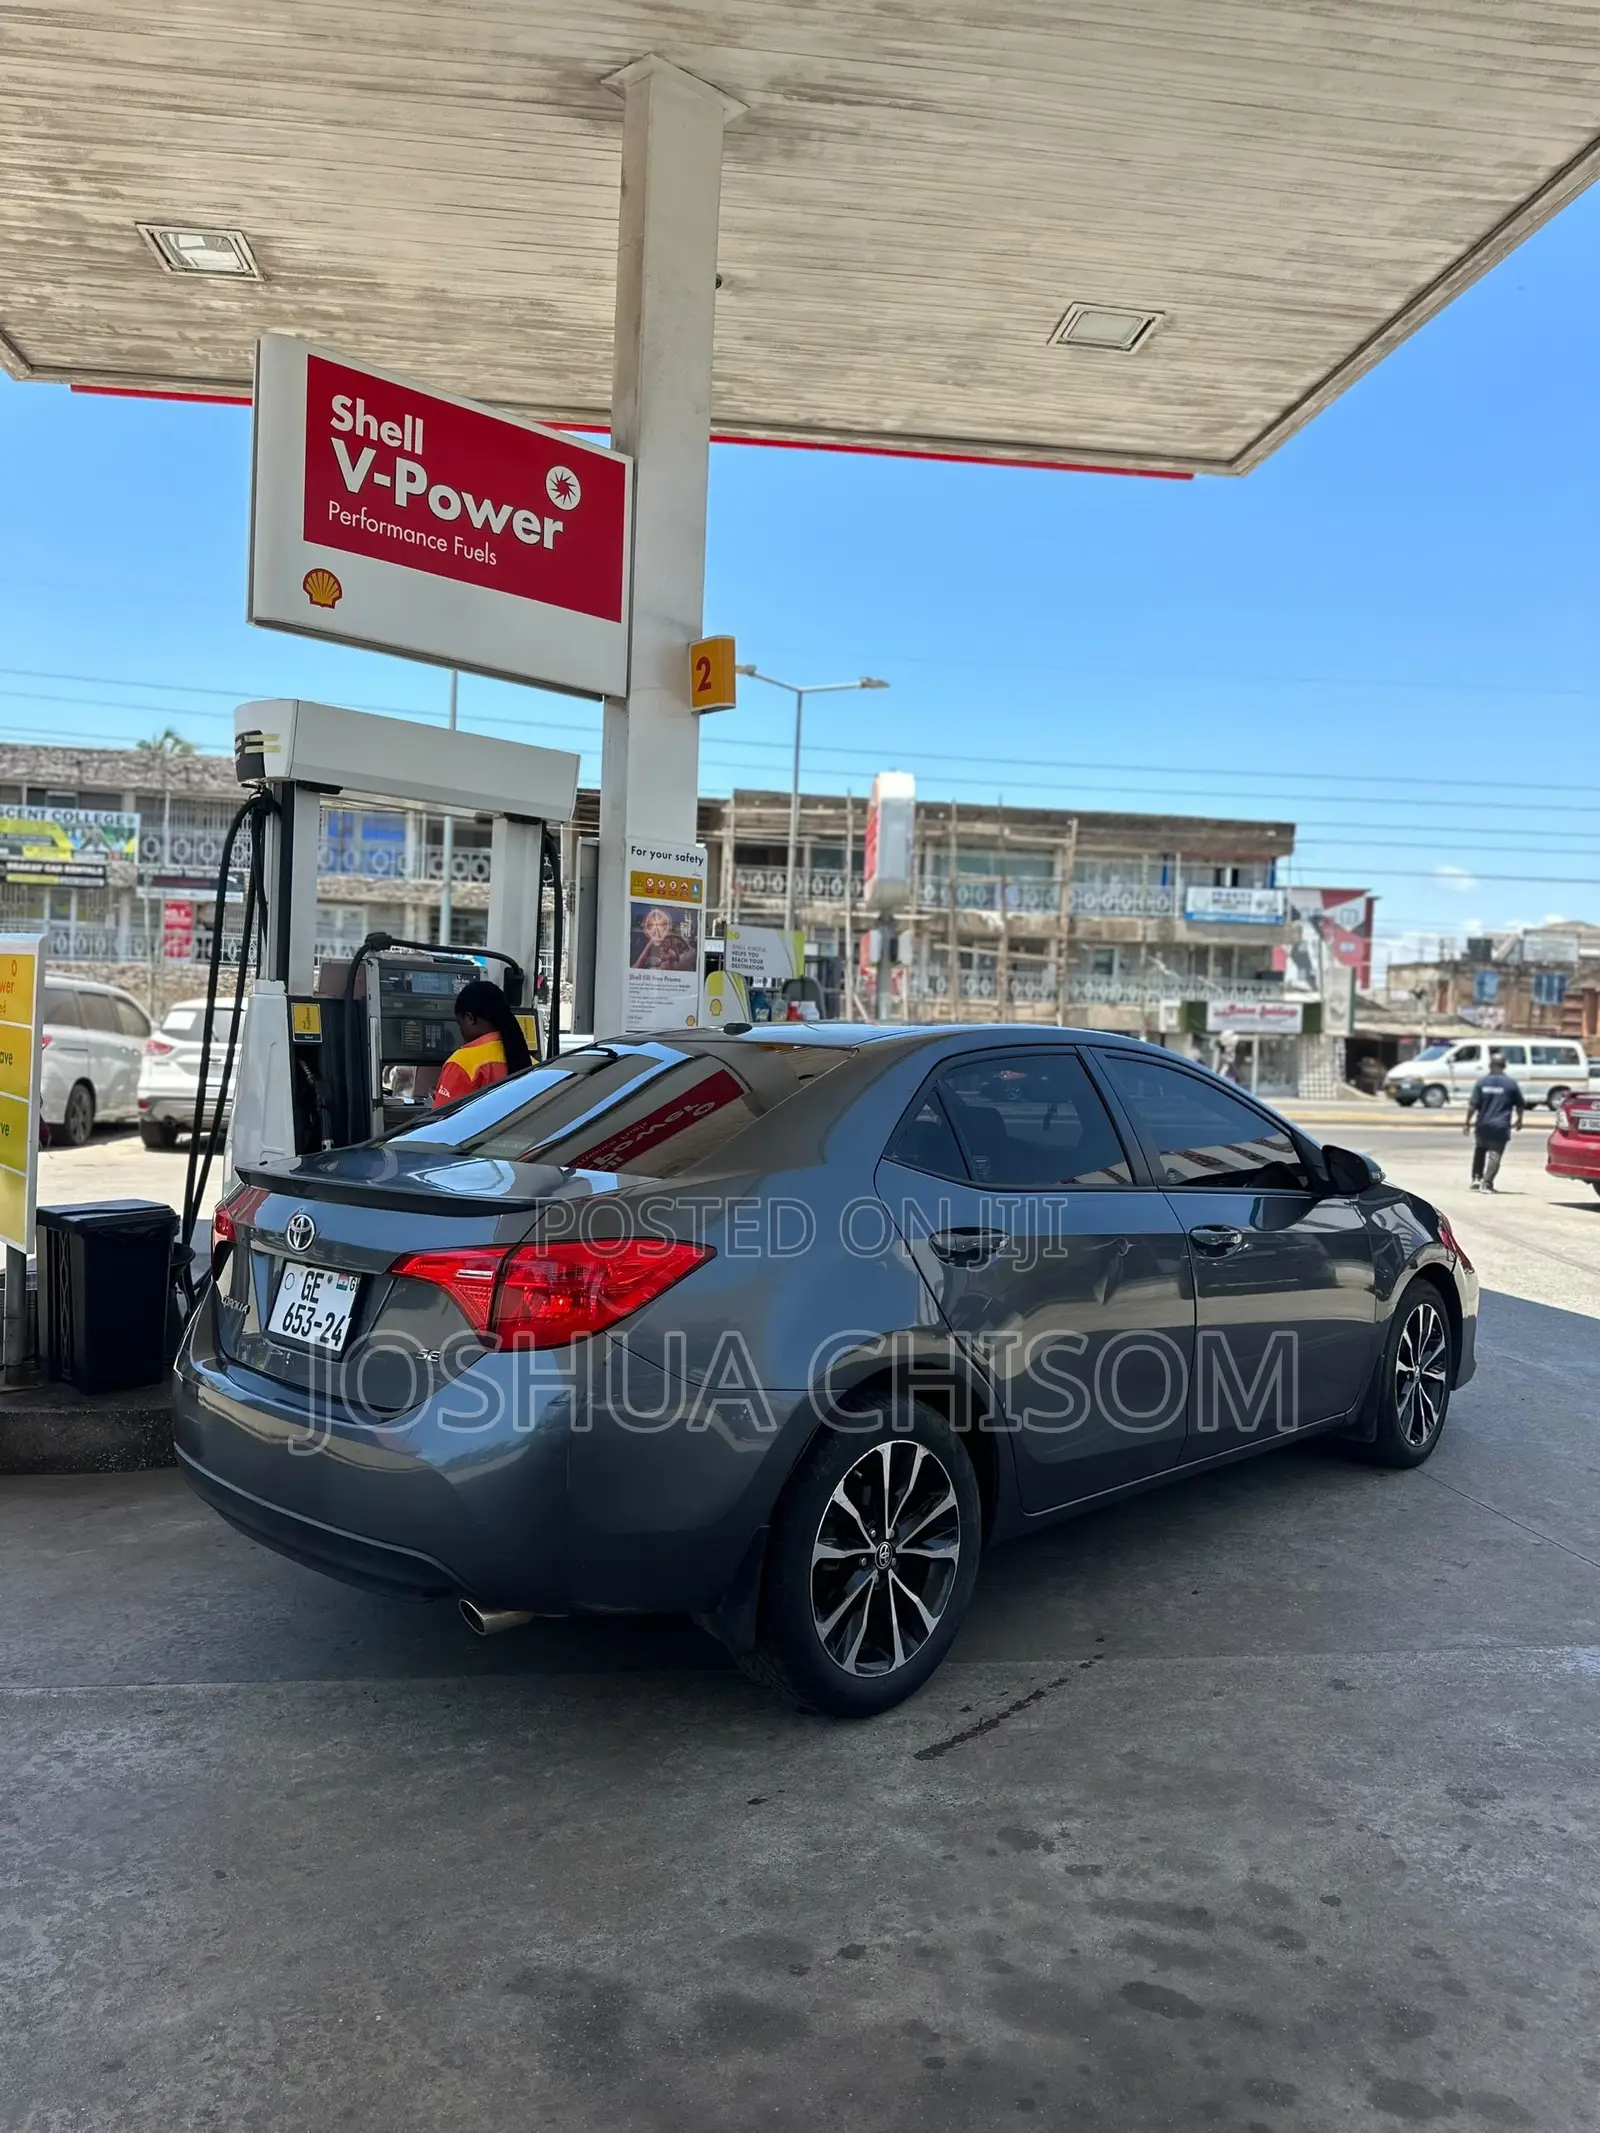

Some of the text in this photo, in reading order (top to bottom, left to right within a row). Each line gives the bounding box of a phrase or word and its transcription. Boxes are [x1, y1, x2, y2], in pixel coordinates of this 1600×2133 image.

[330, 394, 424, 456] Shell
[330, 437, 564, 550] V-Power
[328, 500, 497, 566] Performance Fuels
[696, 656, 712, 692] 2
[631, 845, 704, 867] For your safety
[629, 973, 642, 981] Shell
[731, 962, 765, 971] DESTINATION
[301, 1271, 325, 1305] GE
[282, 1302, 347, 1347] 653-24
